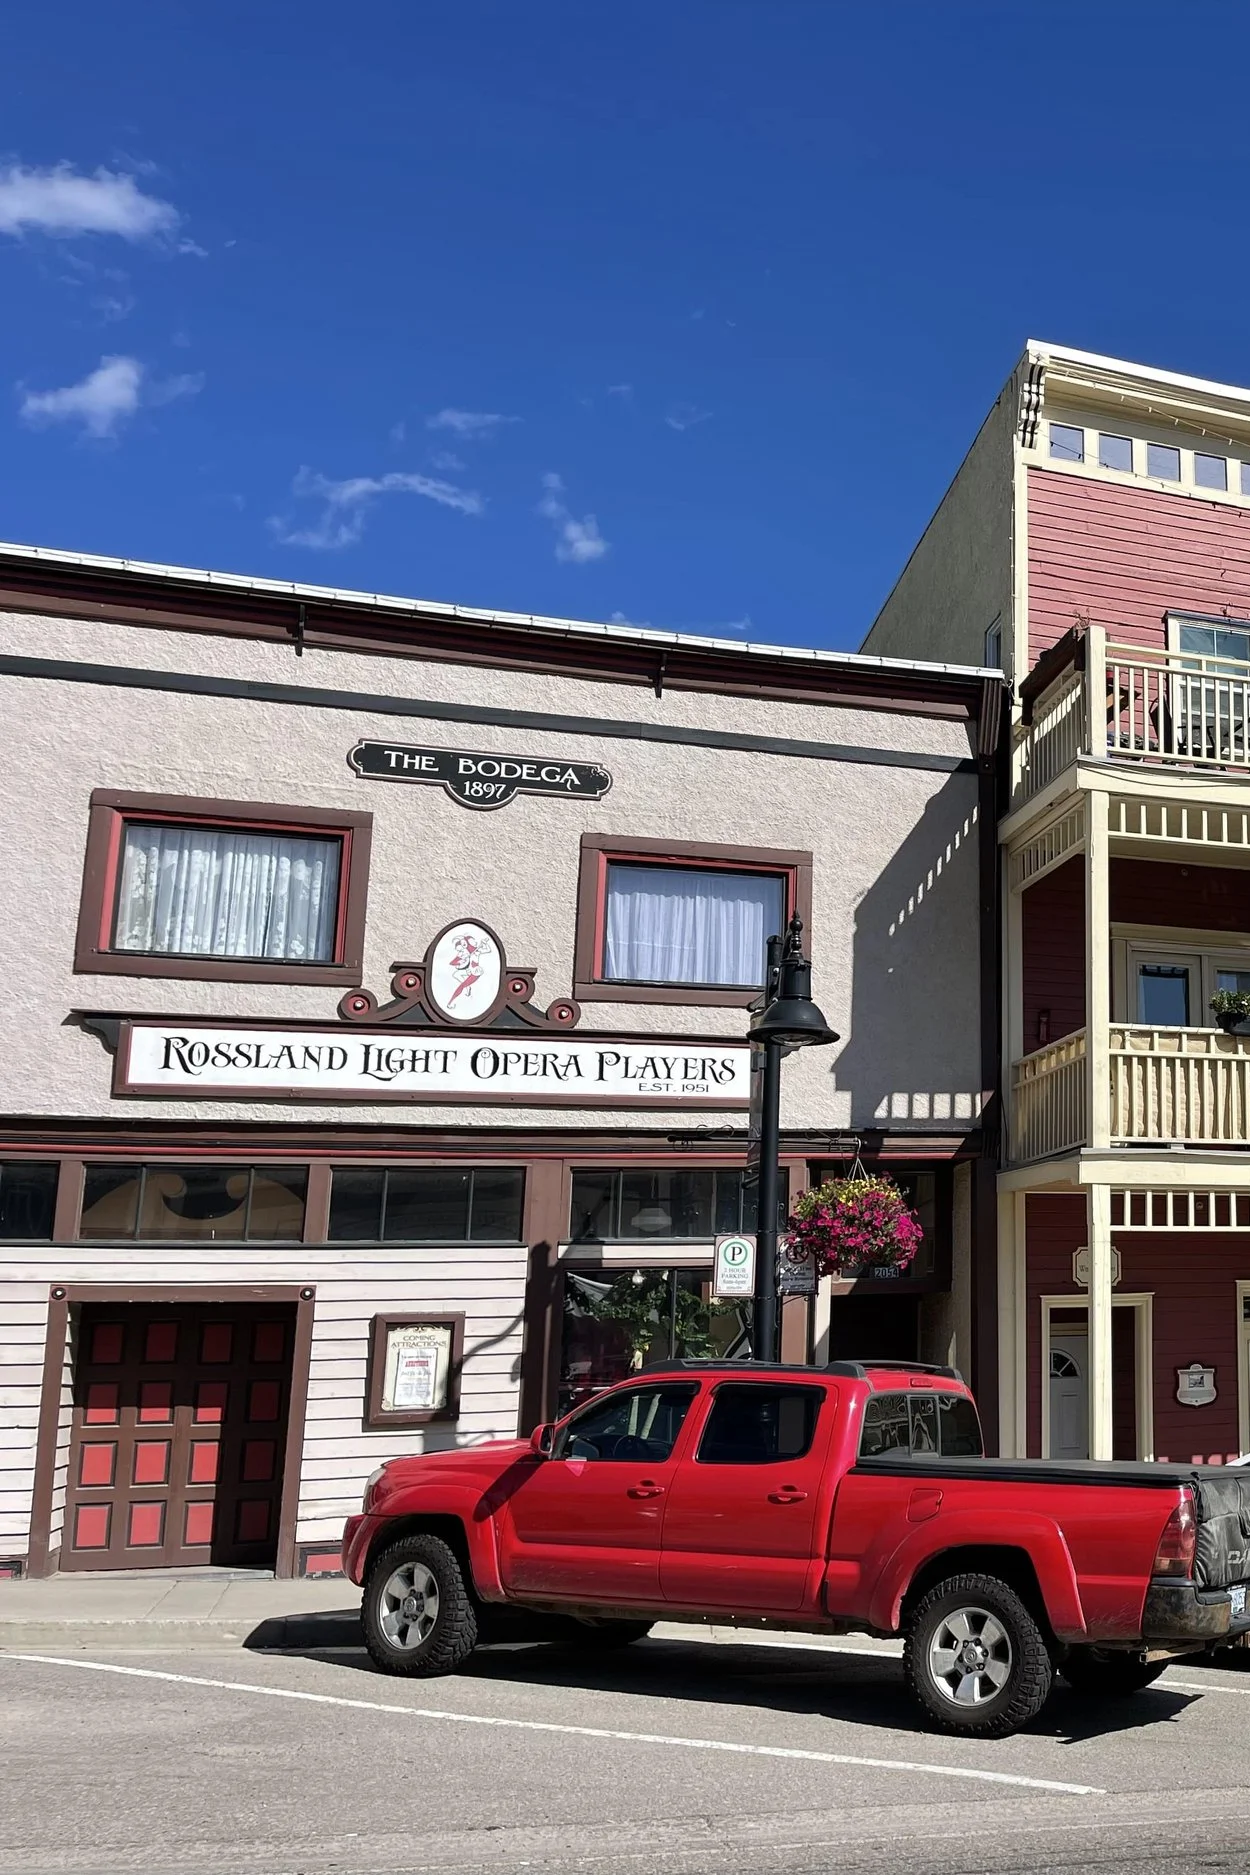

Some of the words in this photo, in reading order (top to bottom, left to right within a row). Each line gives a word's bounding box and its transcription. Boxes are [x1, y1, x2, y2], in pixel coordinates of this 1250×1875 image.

[384, 750, 439, 772] THE
[457, 757, 581, 790] BODEGA
[463, 780, 507, 799] 1897
[158, 1036, 349, 1076] ROSSLAND
[358, 1043, 458, 1081] LIGHT
[470, 1046, 585, 1081] OPERA
[593, 1051, 736, 1085] PLAYERS
[638, 1082, 677, 1092] EST.
[681, 1083, 710, 1093] 1951
[731, 1246, 742, 1261] P
[875, 1267, 899, 1278] 2054
